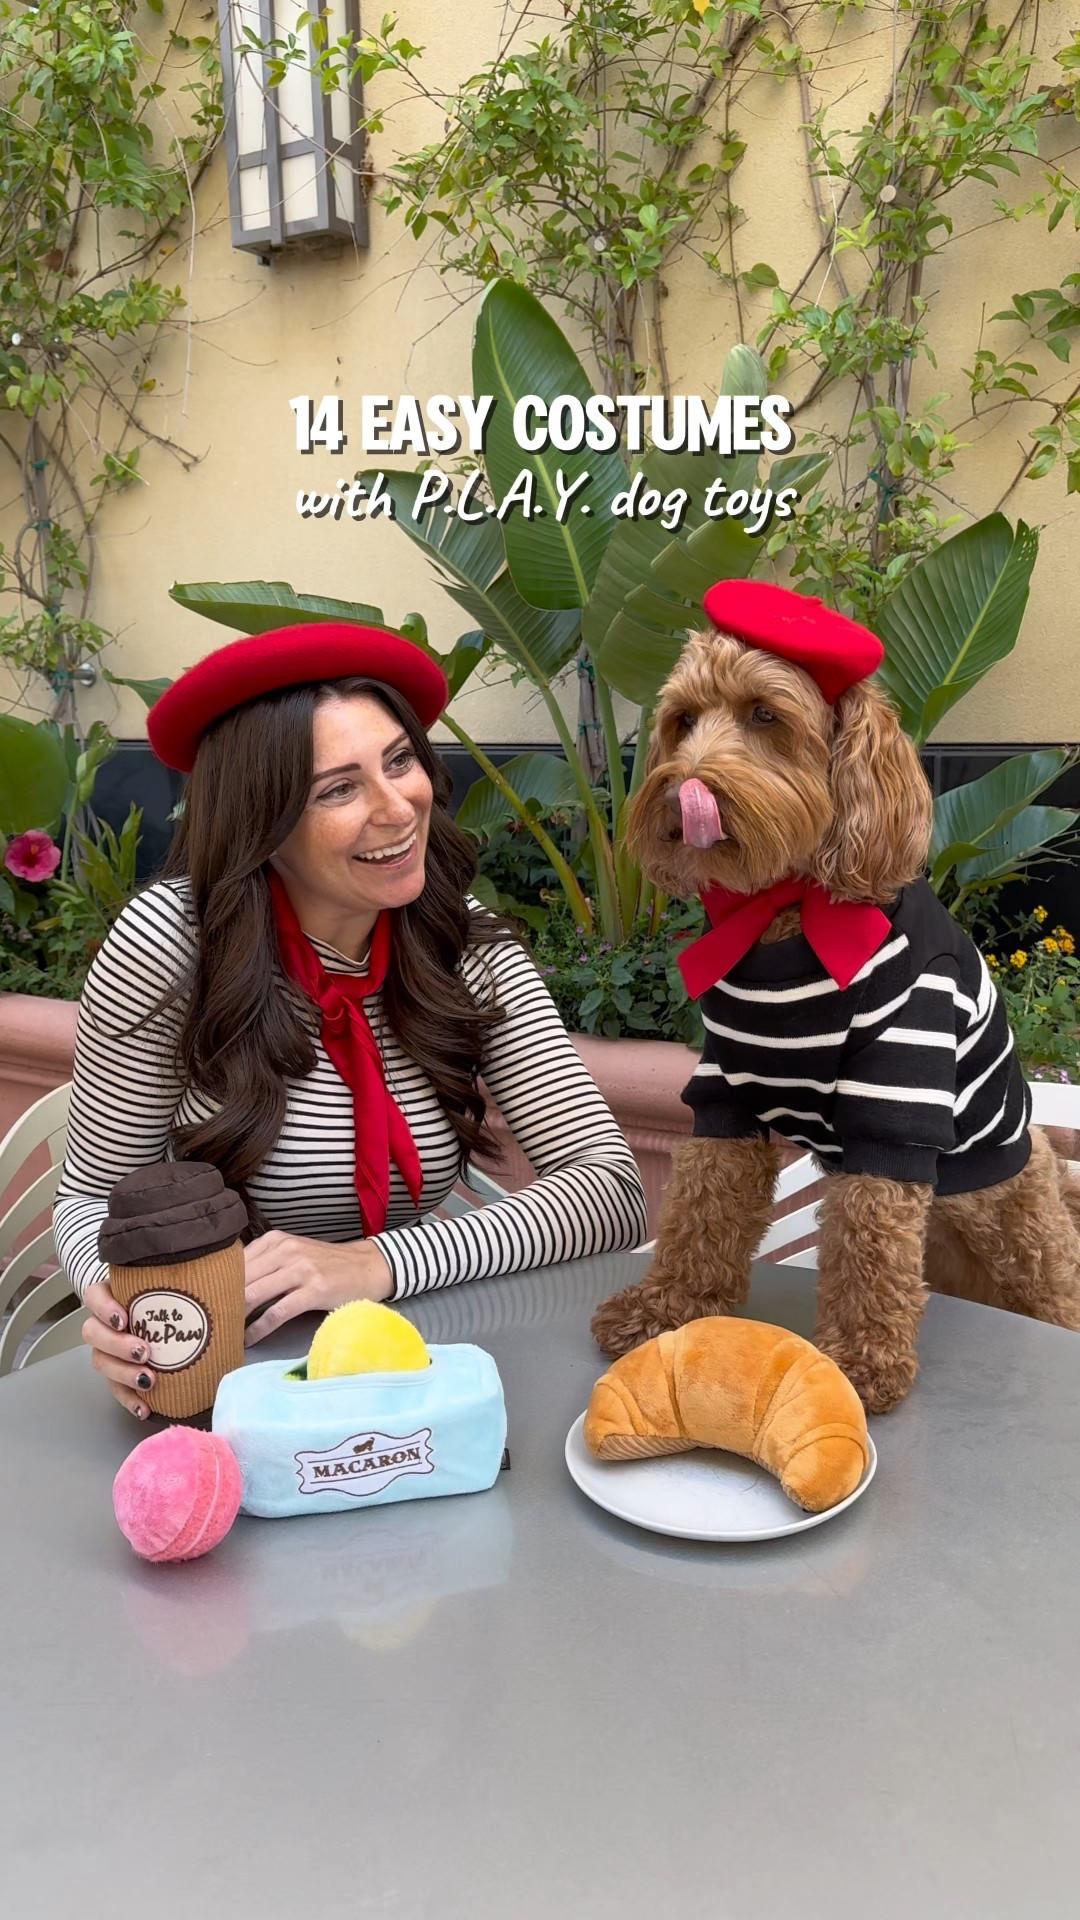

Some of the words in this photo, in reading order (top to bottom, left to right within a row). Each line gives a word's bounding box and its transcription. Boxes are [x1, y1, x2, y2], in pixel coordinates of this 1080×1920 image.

[146, 1309, 170, 1322] Talk
[171, 1308, 183, 1321] to
[134, 1319, 163, 1344] the
[164, 1324, 202, 1344] Paw
[313, 1447, 421, 1478] MACARON
